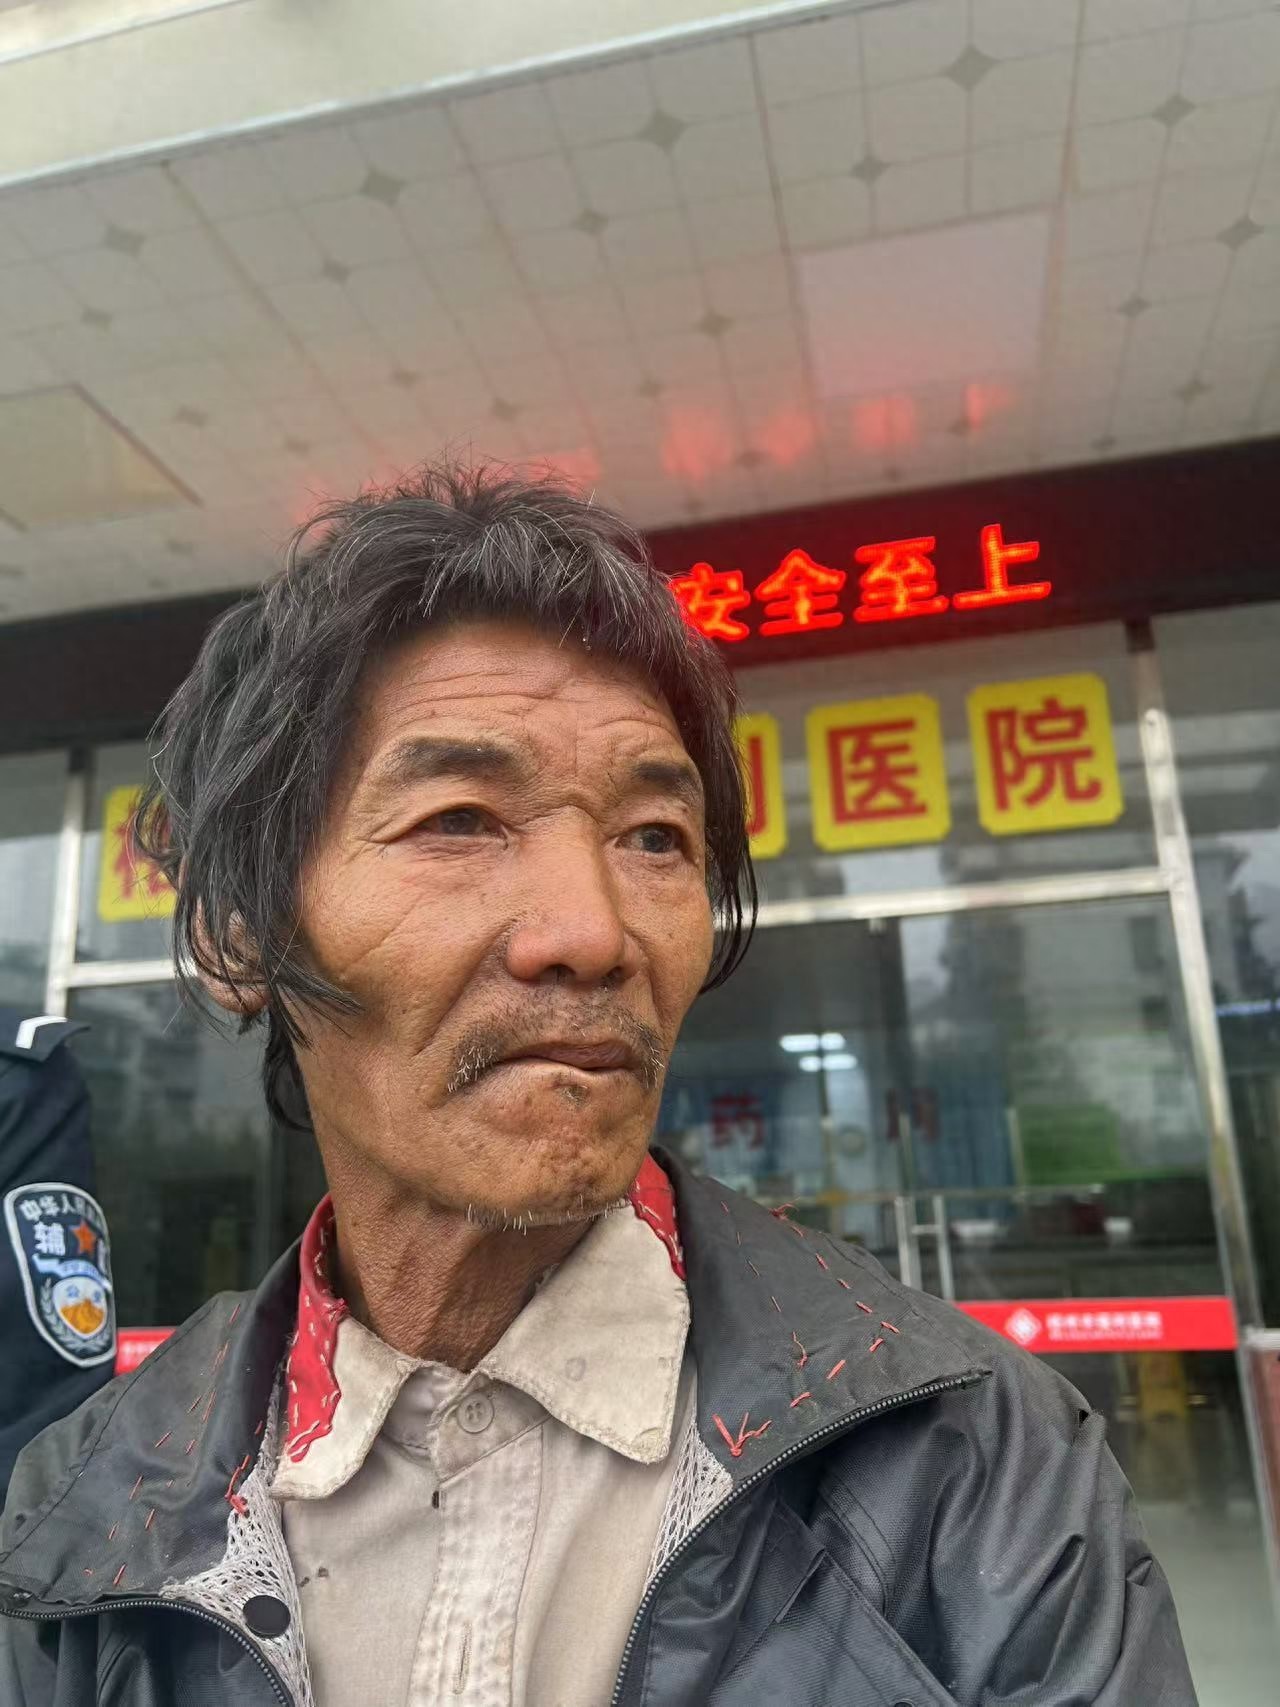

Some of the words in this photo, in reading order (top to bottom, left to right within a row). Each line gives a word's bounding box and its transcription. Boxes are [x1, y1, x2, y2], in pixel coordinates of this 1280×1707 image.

[668, 523, 1052, 642] 安全至上
[745, 697, 1102, 835] 医院
